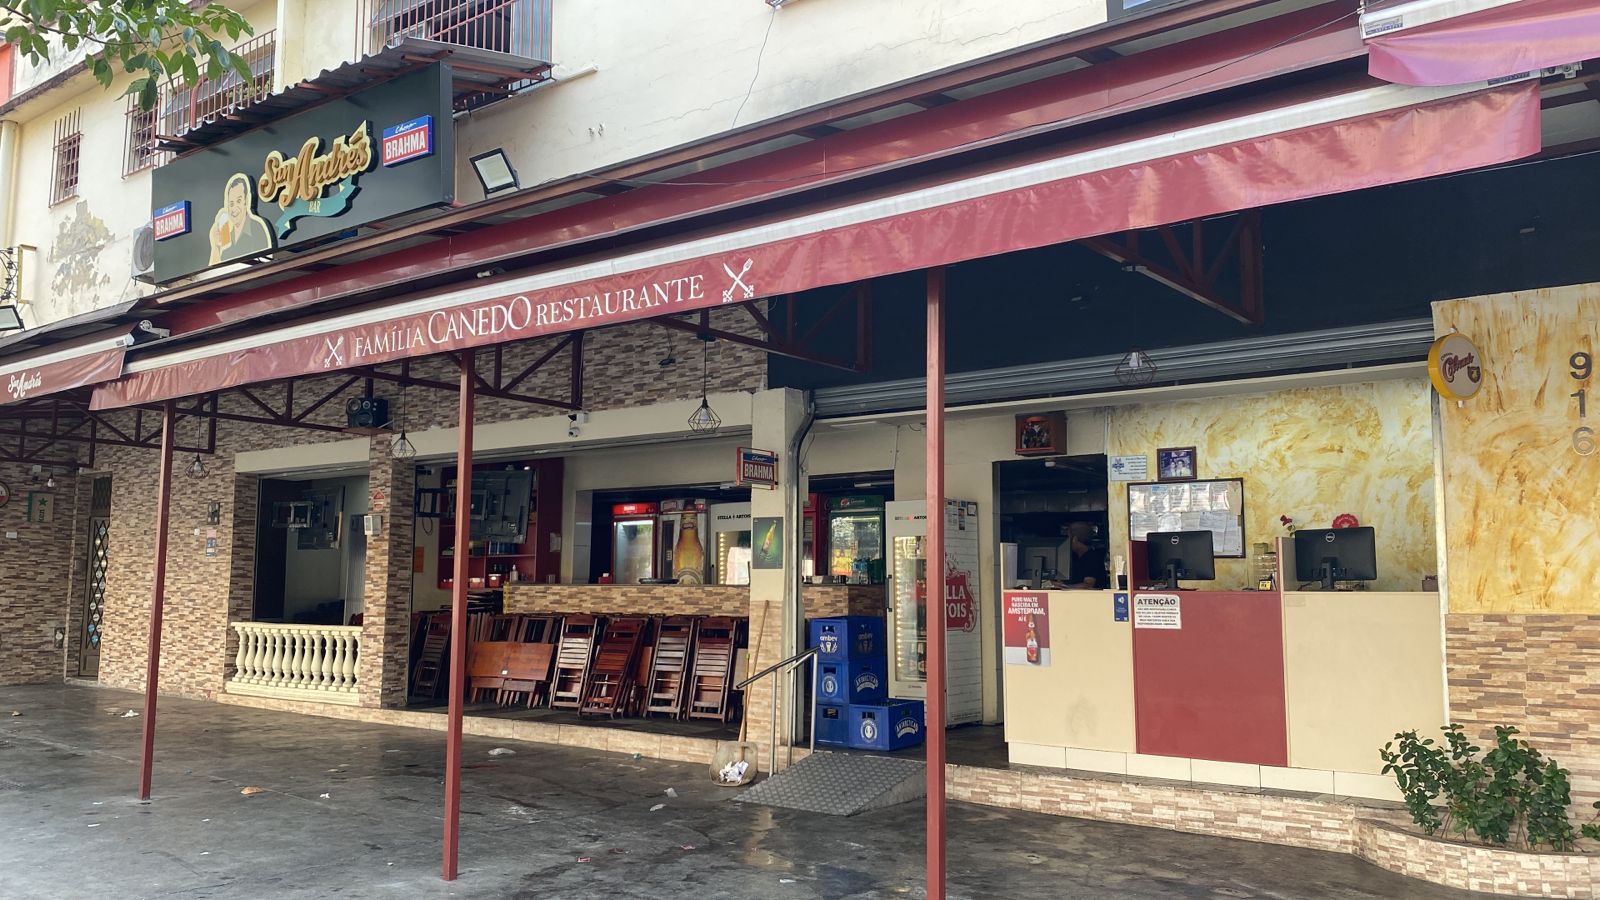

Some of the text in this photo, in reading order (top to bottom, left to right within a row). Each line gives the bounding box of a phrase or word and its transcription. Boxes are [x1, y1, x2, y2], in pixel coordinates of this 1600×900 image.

[385, 130, 427, 160] BRAHMA
[260, 130, 370, 208] San Andrés
[308, 199, 321, 213] BAR
[155, 212, 185, 236] BRAHMA
[355, 275, 704, 357] FAMÍLIA CANEDO RESTAURANTE
[744, 463, 774, 480] BRAHMA
[945, 585, 966, 600] LLA
[1137, 598, 1176, 607] ATENÇÃO
